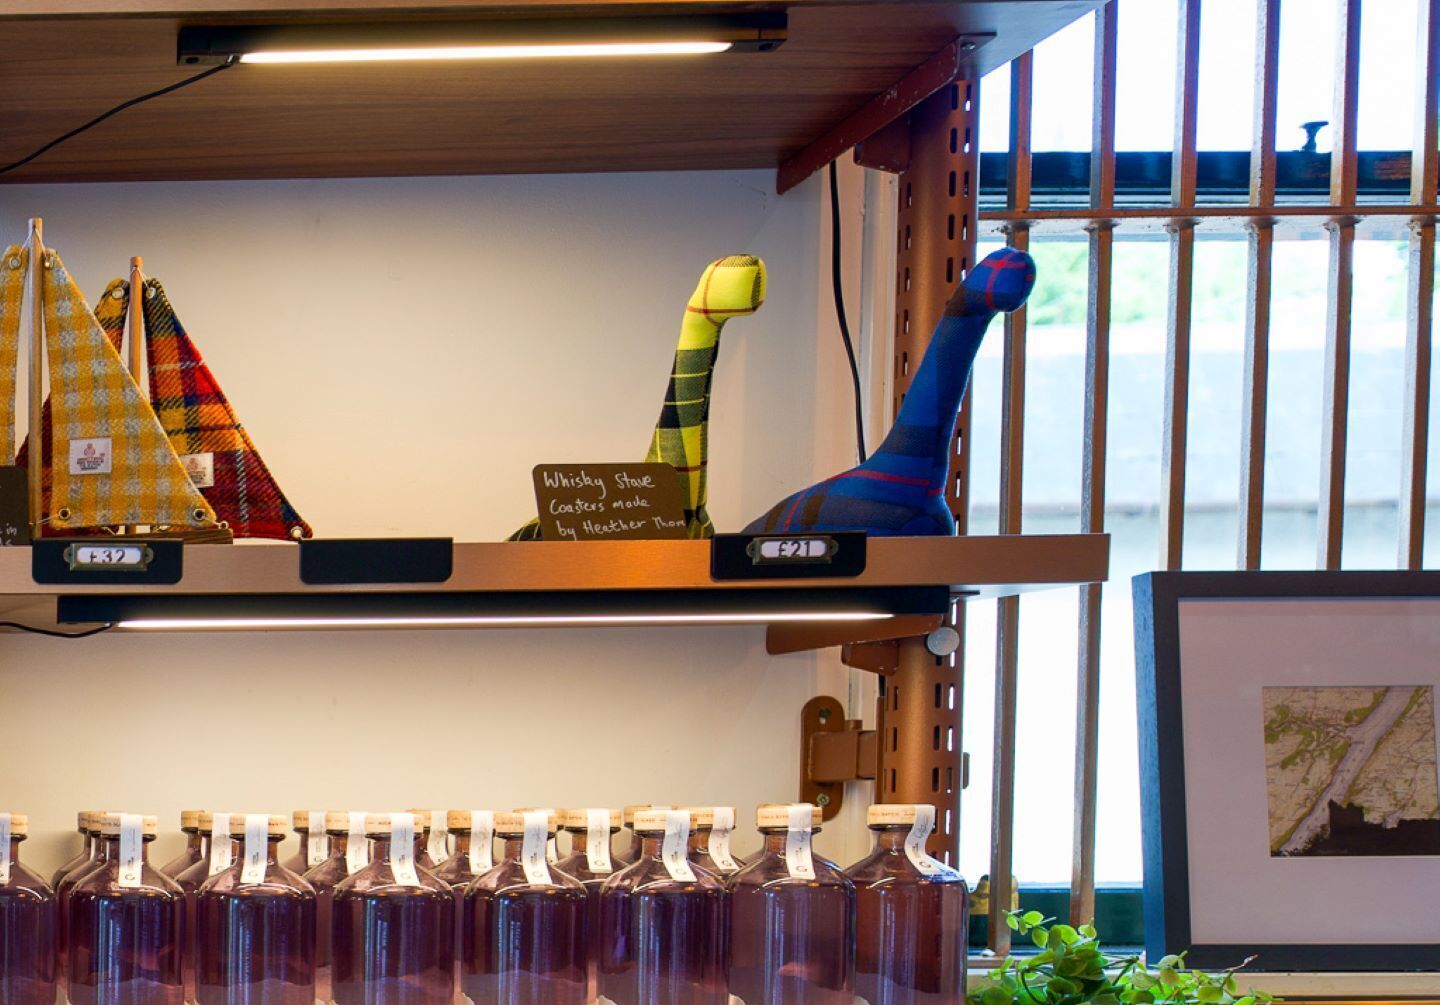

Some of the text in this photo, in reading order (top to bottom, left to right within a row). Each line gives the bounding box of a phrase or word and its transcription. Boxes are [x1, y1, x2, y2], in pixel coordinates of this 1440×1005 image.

[543, 470, 655, 499] Whisky Stave
[550, 498, 651, 516] Coasters made
[555, 520, 578, 542] by
[582, 519, 647, 535] Heather
[88, 549, 126, 564] £32
[777, 540, 812, 558] £21
